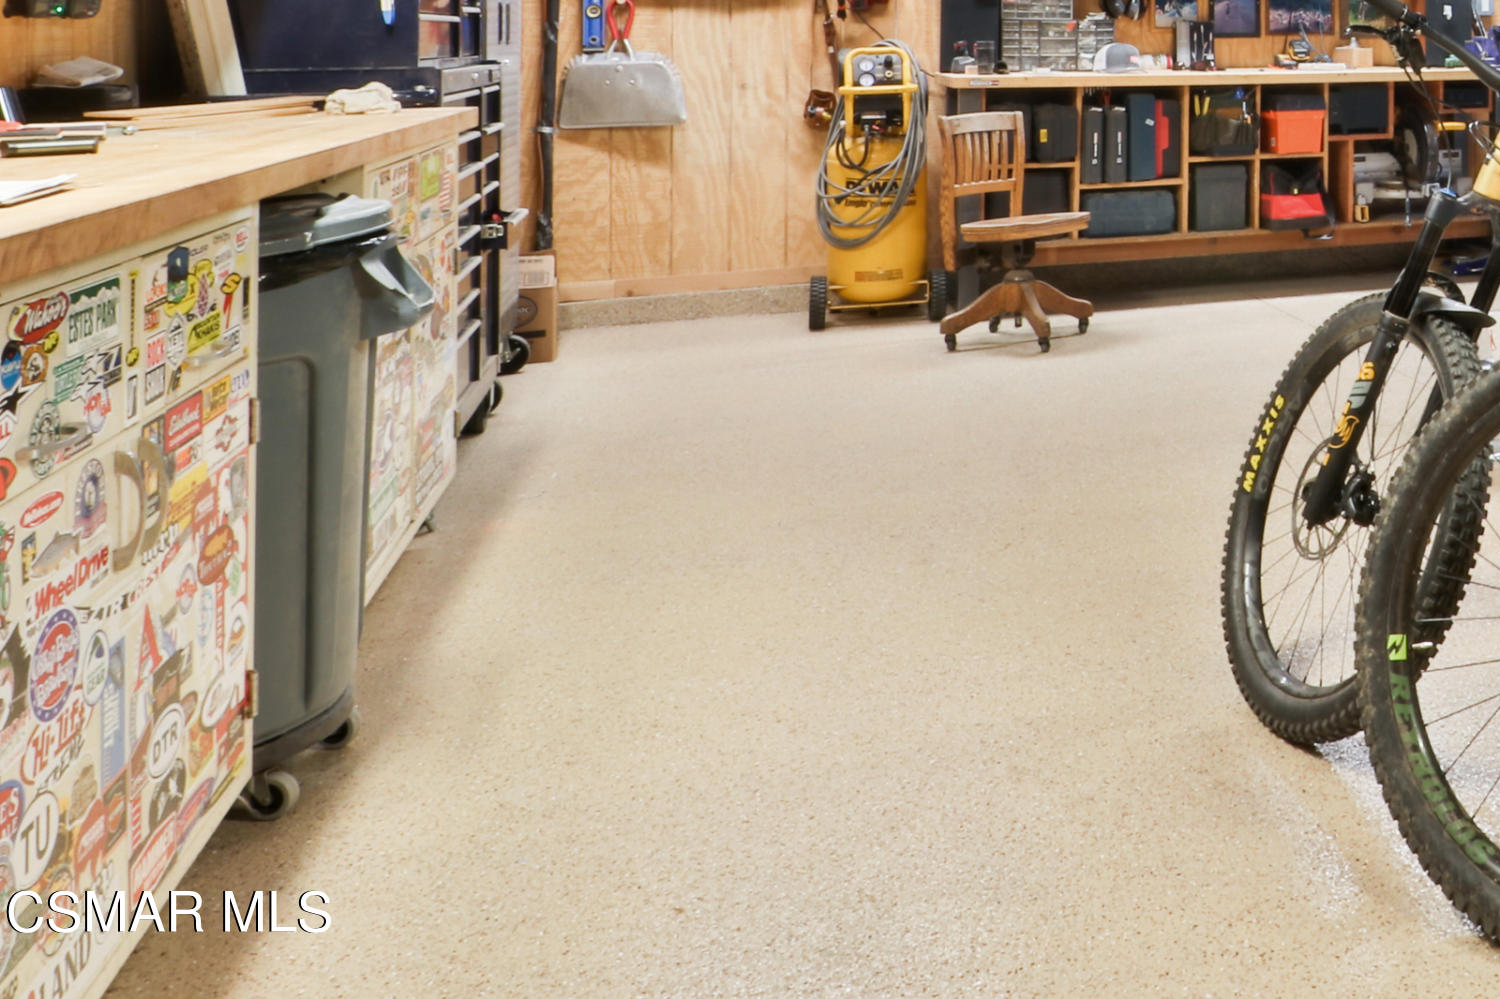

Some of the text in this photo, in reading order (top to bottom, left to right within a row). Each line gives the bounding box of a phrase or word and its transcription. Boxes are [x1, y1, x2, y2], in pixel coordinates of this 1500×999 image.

[69, 307, 94, 344] ESTES
[95, 298, 117, 331] PARK
[1242, 394, 1285, 493] MAXXIS
[1388, 672, 1496, 865] REYNOLDS
[21, 804, 50, 876] TU
